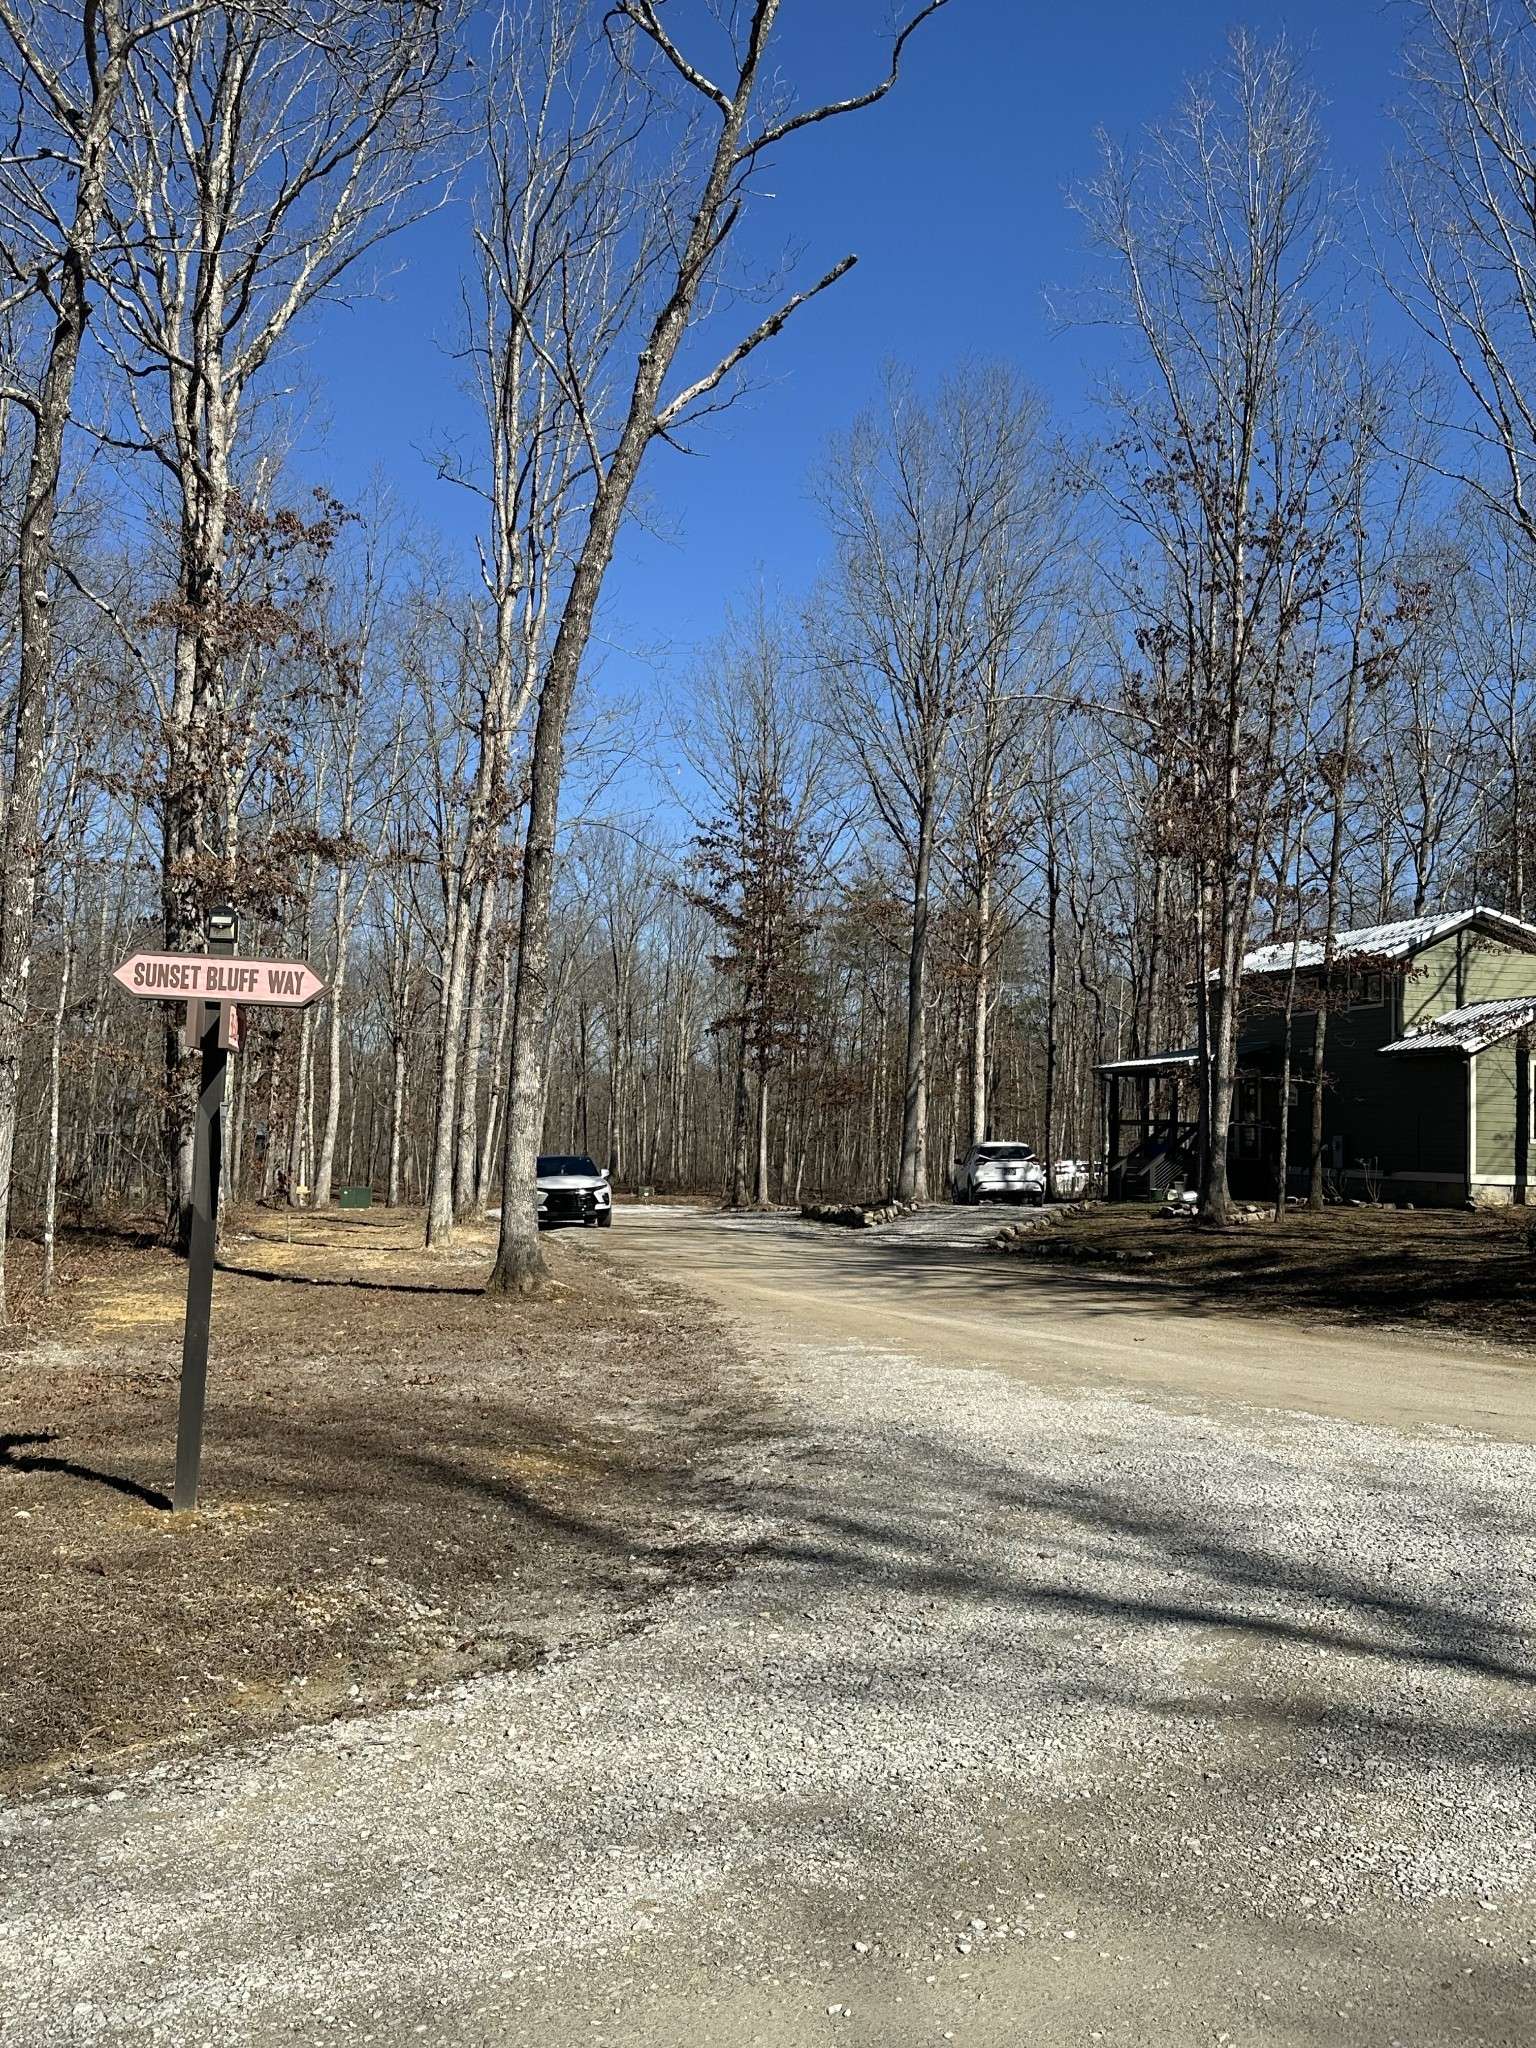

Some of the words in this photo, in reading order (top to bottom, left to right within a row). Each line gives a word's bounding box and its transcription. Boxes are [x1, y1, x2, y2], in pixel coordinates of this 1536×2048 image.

[134, 962, 201, 990] SUNSET
[206, 966, 260, 992] BLUFF
[268, 969, 305, 996] WAY
